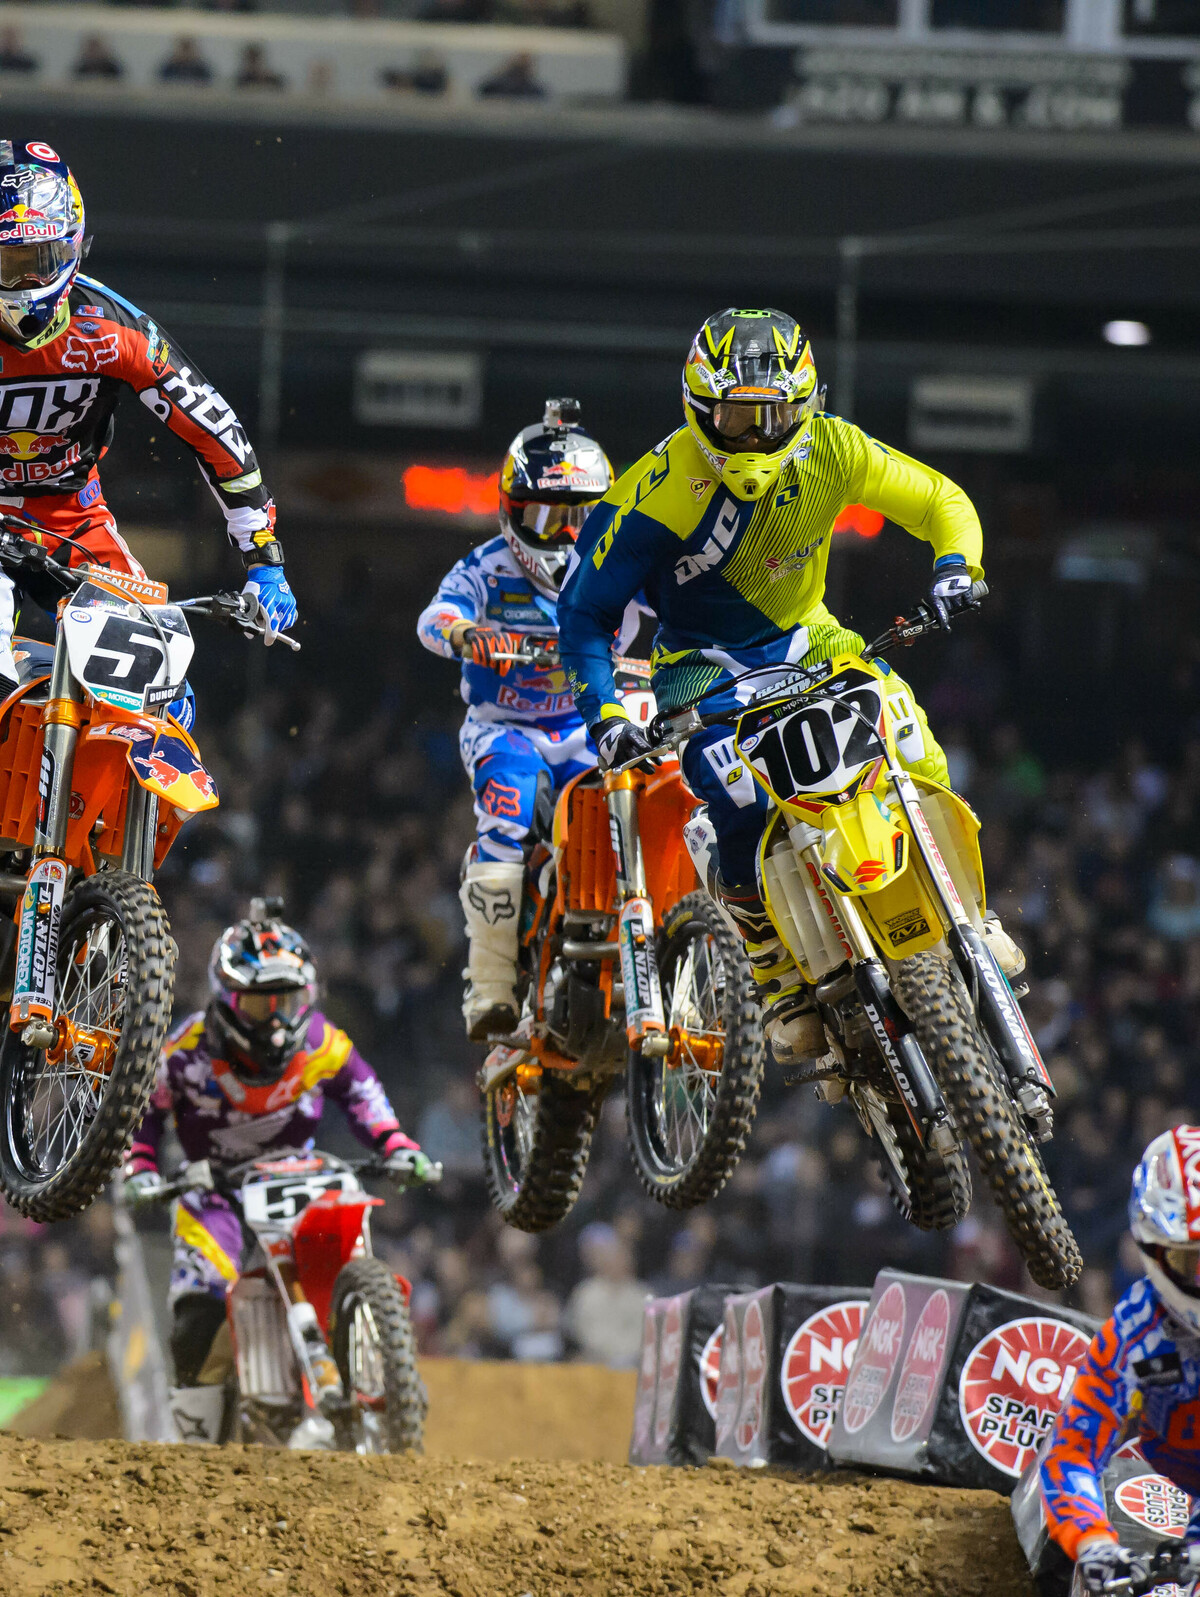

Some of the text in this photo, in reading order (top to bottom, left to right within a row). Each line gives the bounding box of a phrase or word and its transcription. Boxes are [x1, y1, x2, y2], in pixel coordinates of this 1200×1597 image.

[23, 224, 57, 240] Bull
[36, 318, 68, 346] FOX
[28, 442, 82, 483] Bull
[537, 476, 600, 490] Red Bull
[91, 571, 163, 599] RENTHAL
[83, 615, 174, 694] 5
[108, 692, 143, 707] MOTOREX
[497, 685, 551, 712] Red
[748, 688, 885, 802] 102
[15, 910, 35, 994] MOTOREX
[31, 886, 53, 995] DNLOP
[630, 920, 652, 1006] DNLOP
[863, 1003, 918, 1108] DUNLOP
[1142, 1481, 1165, 1526] PLUGS
[1167, 1486, 1189, 1527] SPARK
